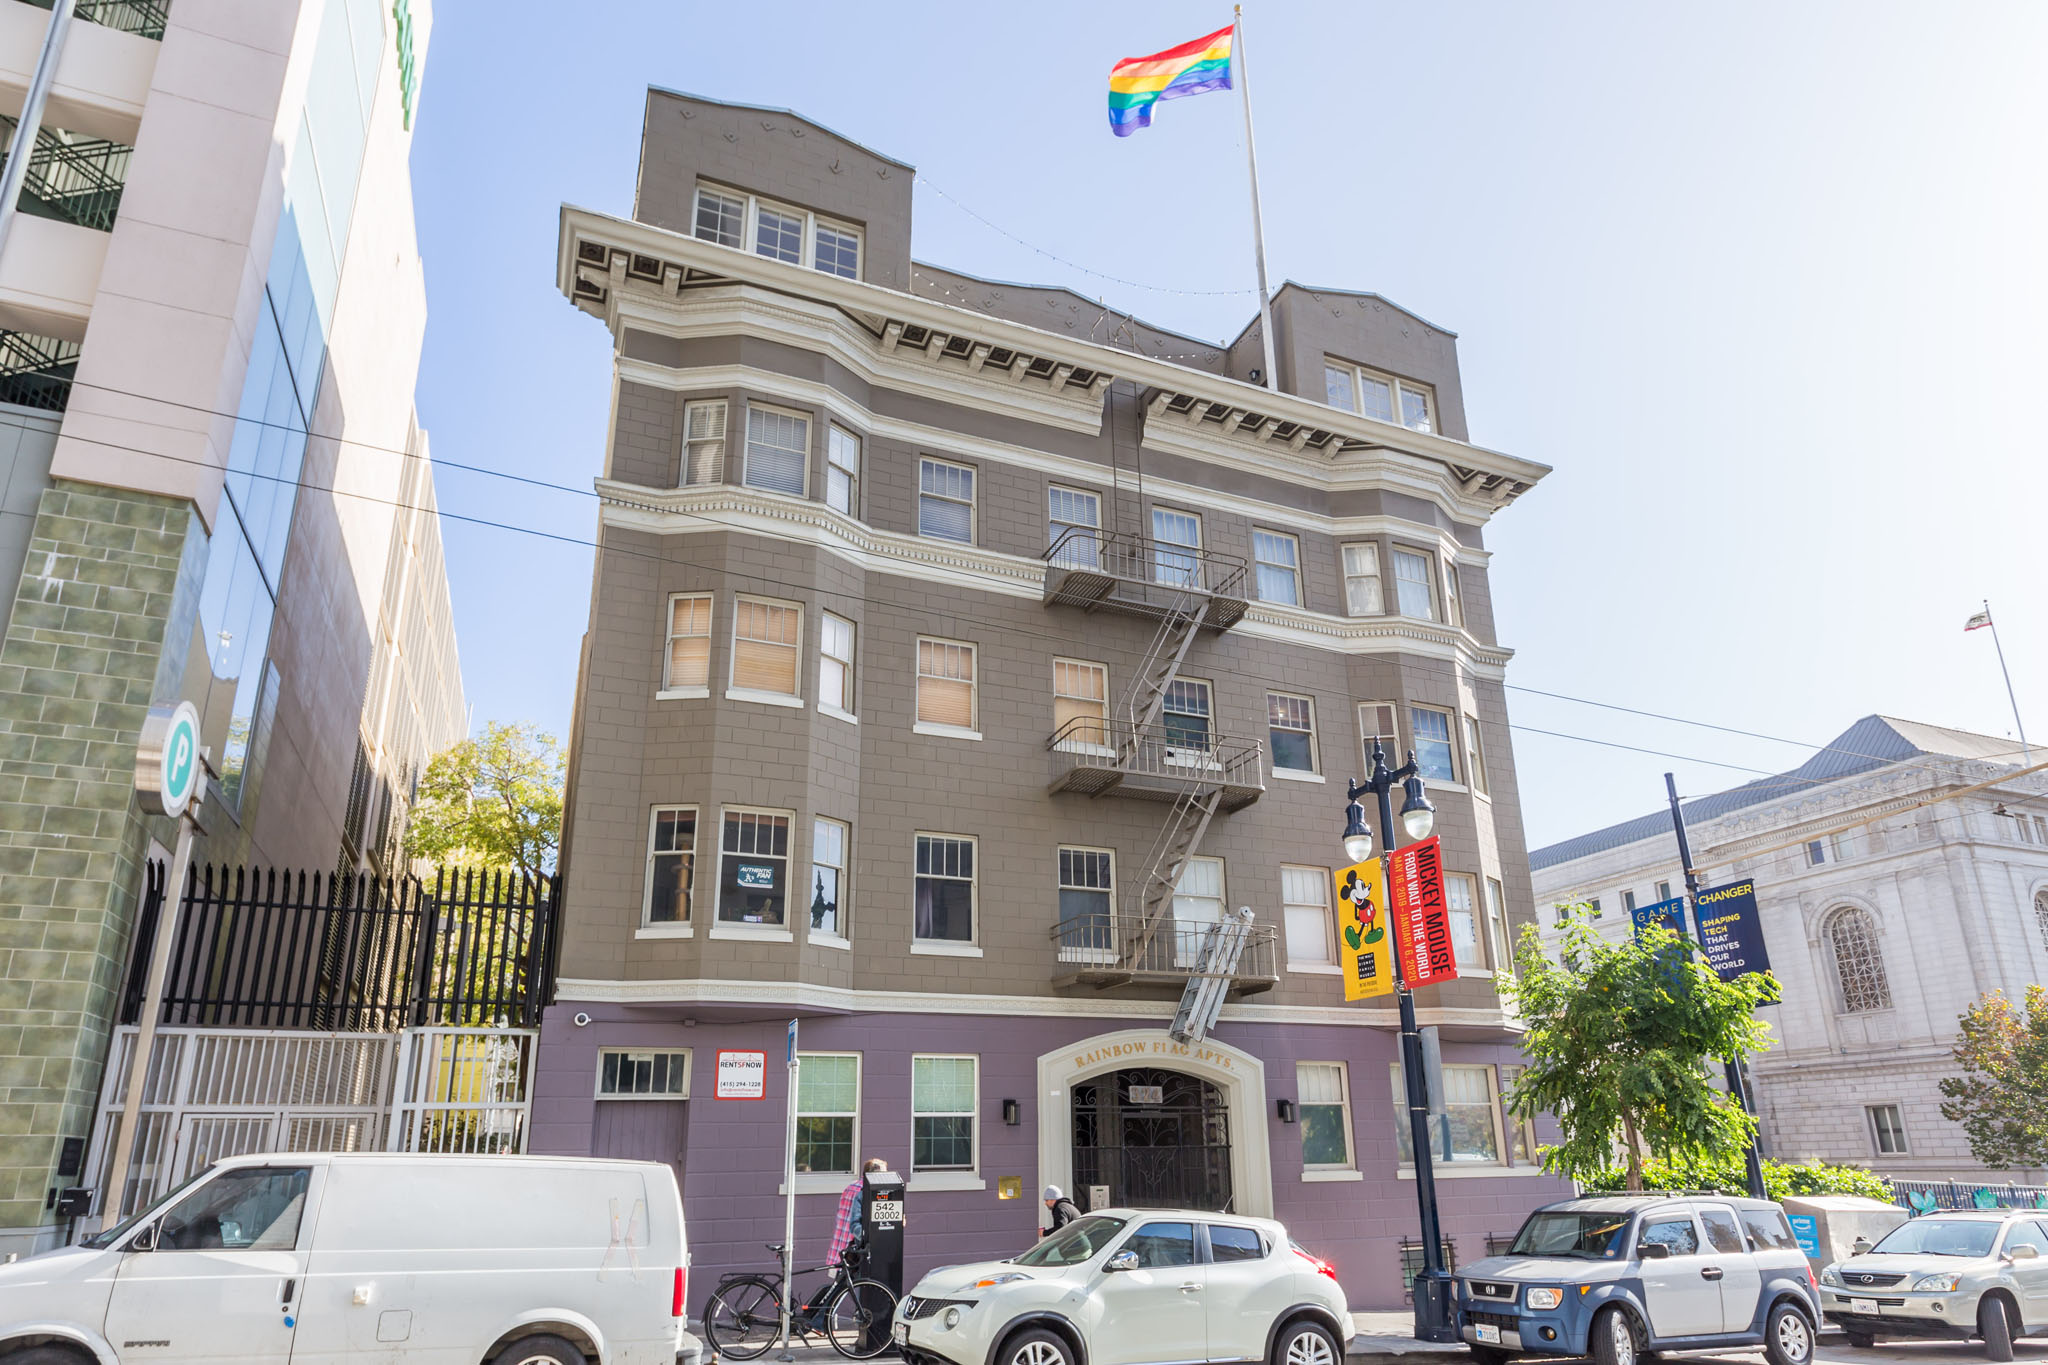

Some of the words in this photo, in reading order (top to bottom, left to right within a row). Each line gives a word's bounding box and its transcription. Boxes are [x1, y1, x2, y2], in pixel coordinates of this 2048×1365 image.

[171, 732, 189, 782] P
[1394, 855, 1403, 872] MAY
[1404, 851, 1417, 880] FROM
[1417, 844, 1441, 907] MICKEY
[1397, 886, 1407, 906] 2019
[1407, 880, 1421, 906] WALT
[1698, 884, 1752, 905] CHANGER
[1410, 906, 1423, 921] TO
[1636, 903, 1679, 922] GAME
[1702, 913, 1741, 928] SHAPING
[1400, 913, 1413, 947] JANUARY
[1412, 921, 1425, 942] THE
[1703, 925, 1728, 936] TECH
[1705, 934, 1729, 945] THAT
[1425, 911, 1451, 975] MOUSE
[1708, 941, 1740, 954] DRIVES
[1415, 942, 1430, 979] WORLD
[1710, 953, 1730, 963] OUR
[1712, 959, 1745, 971] WORLD
[1406, 959, 1418, 981] 2020
[1074, 1041, 1146, 1068] RAINBOW
[1153, 1042, 1190, 1056] FLAG
[874, 1211, 900, 1220] 03002
[875, 1203, 895, 1211] 542
